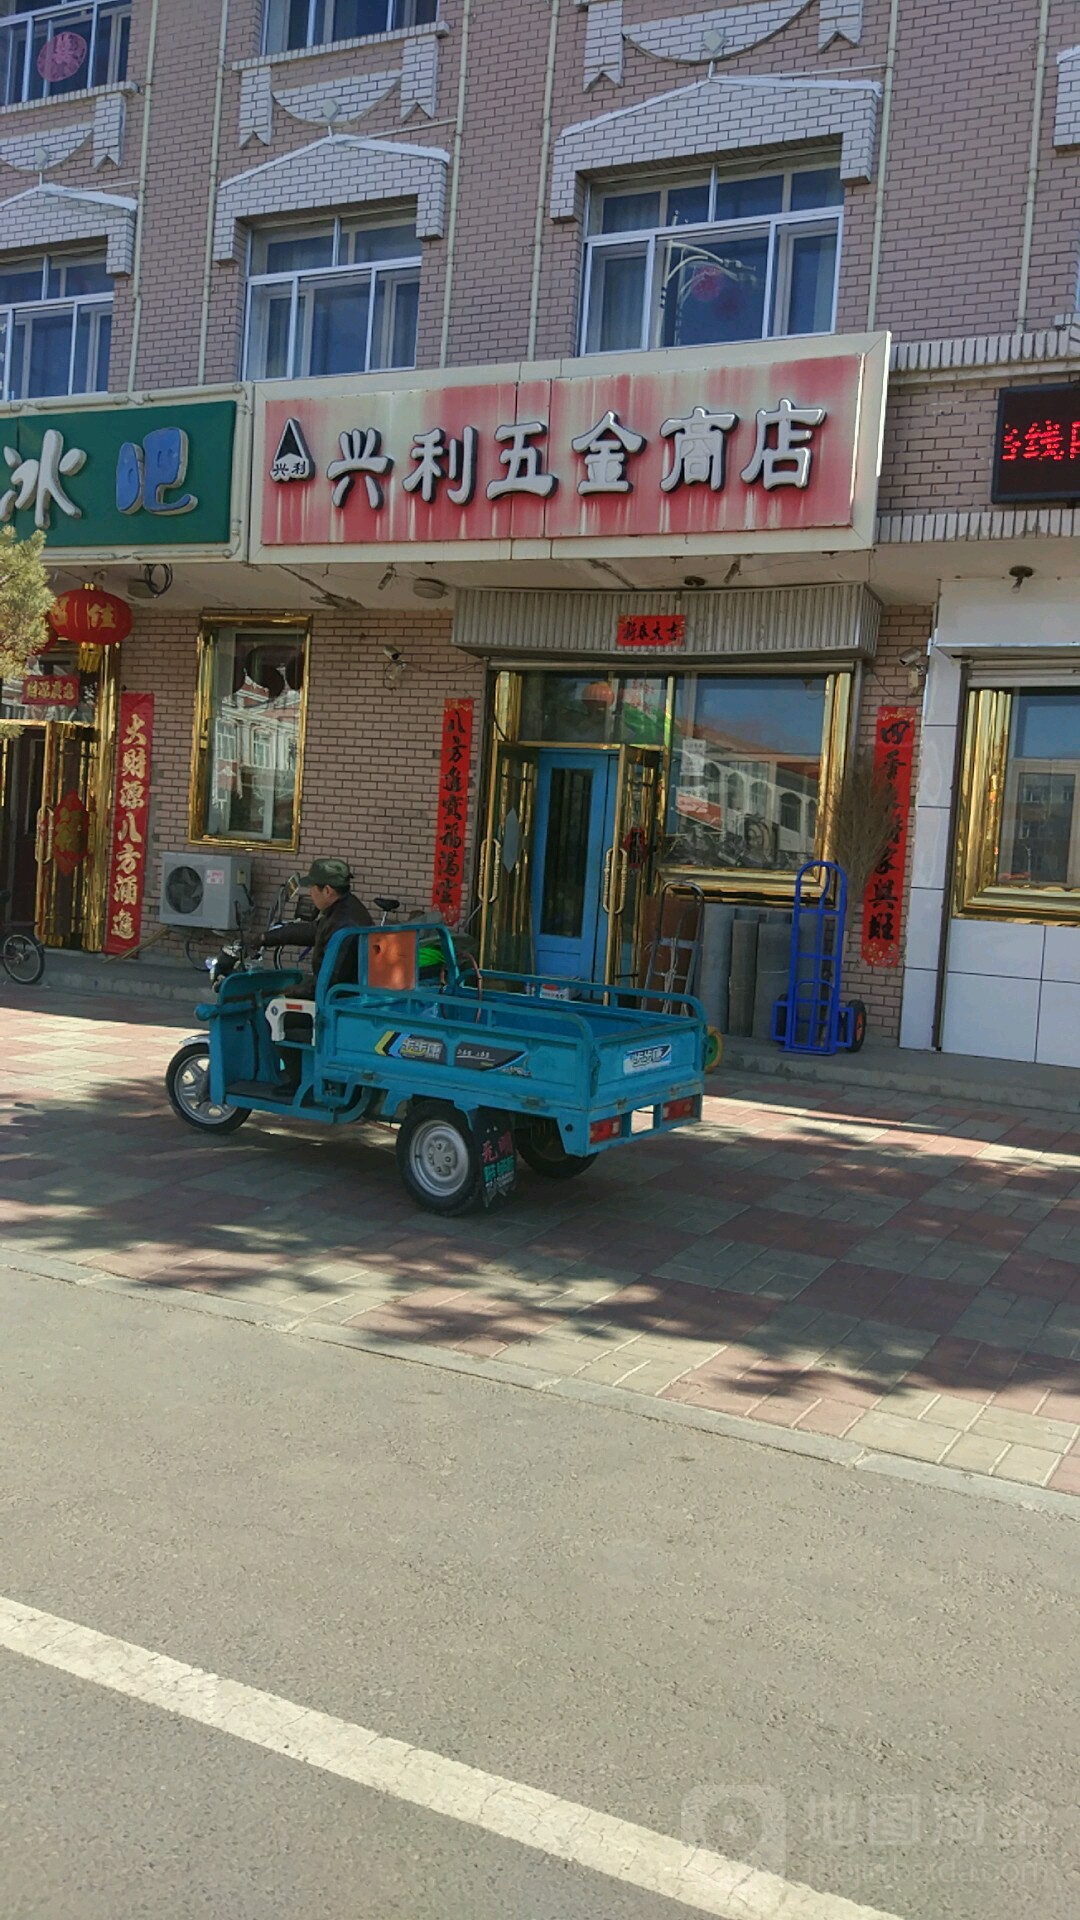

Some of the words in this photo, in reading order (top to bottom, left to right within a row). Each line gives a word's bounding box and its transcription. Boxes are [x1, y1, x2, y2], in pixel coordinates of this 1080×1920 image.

[0, 427, 199, 530] 冰吧
[272, 460, 306, 477] 兴利
[326, 398, 826, 508] 兴利五金商店
